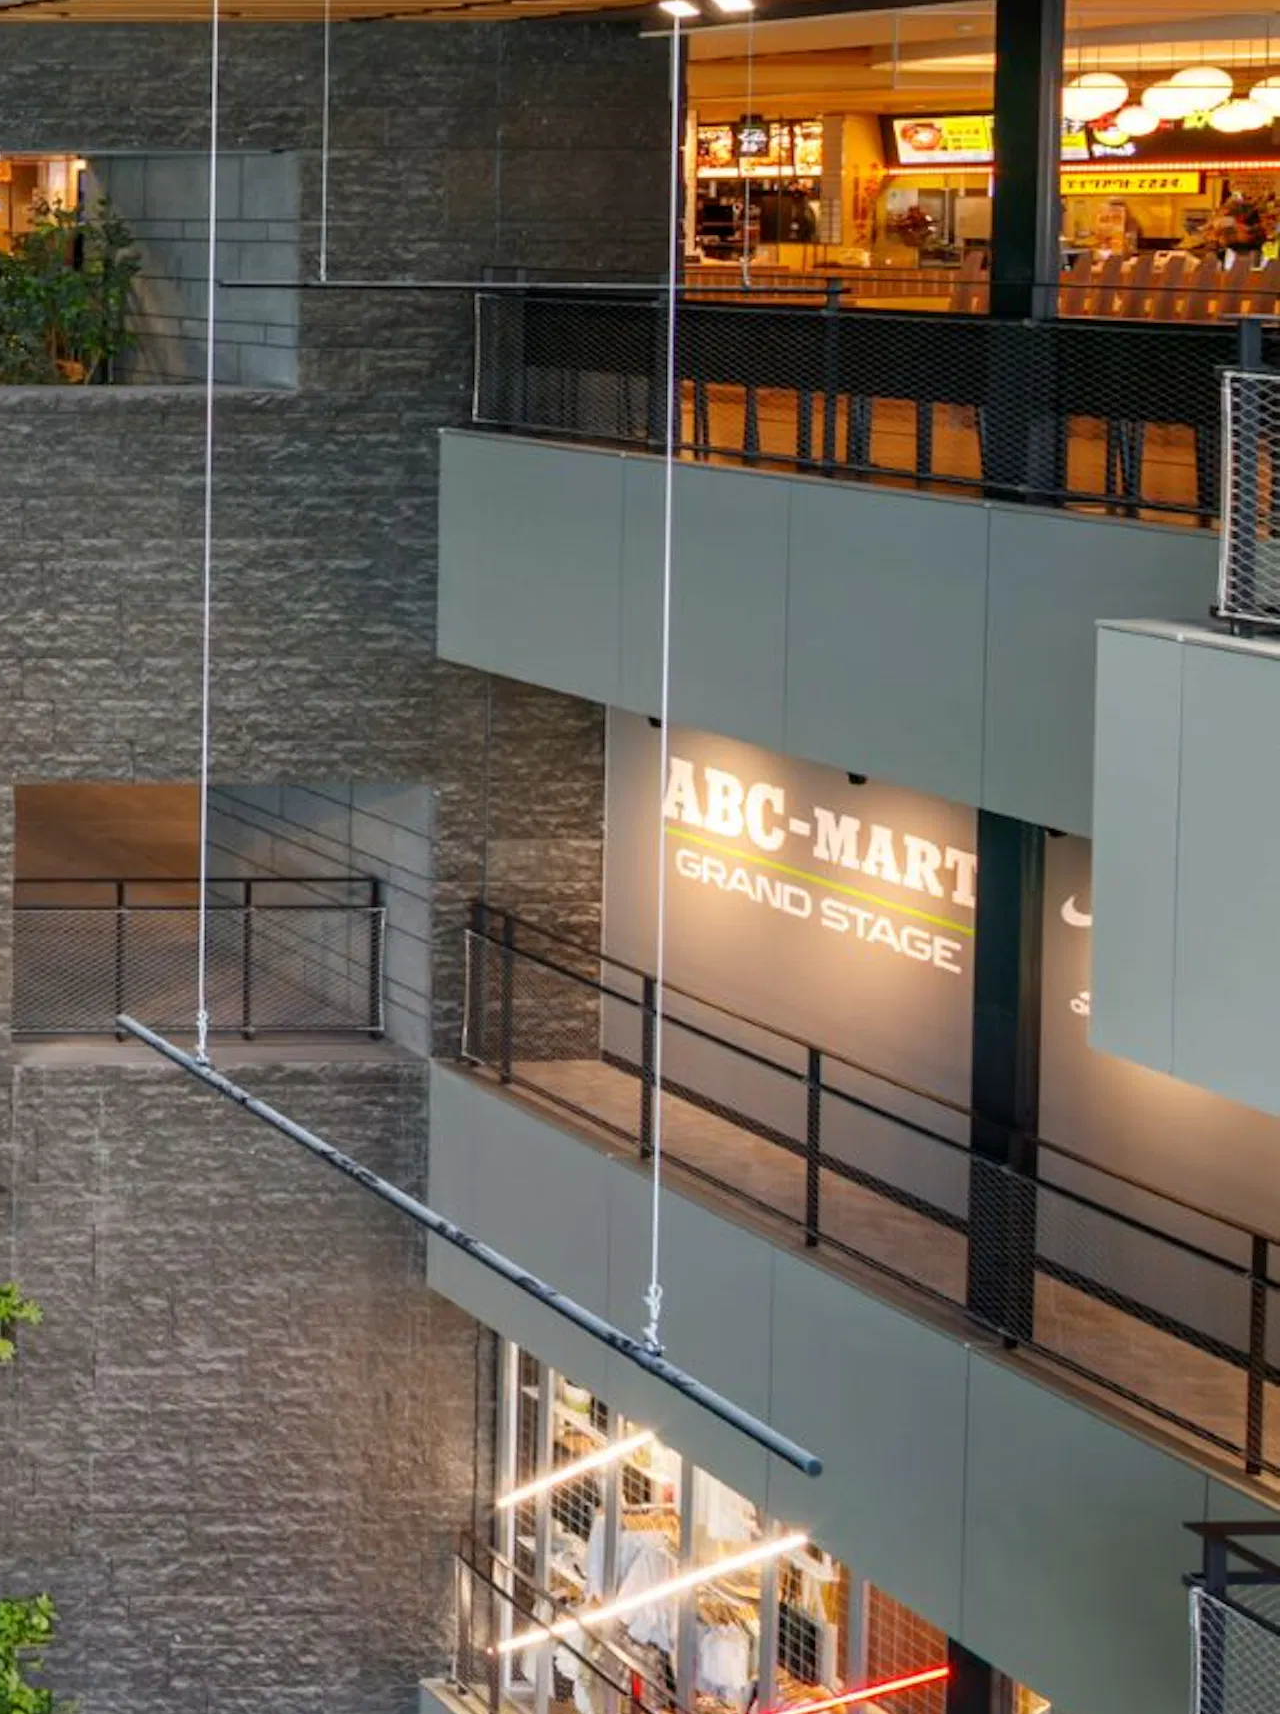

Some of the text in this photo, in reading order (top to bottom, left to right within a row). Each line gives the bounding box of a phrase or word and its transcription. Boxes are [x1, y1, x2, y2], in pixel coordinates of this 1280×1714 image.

[663, 756, 978, 908] ABC-MART
[676, 847, 963, 975] GRAND STAGE
